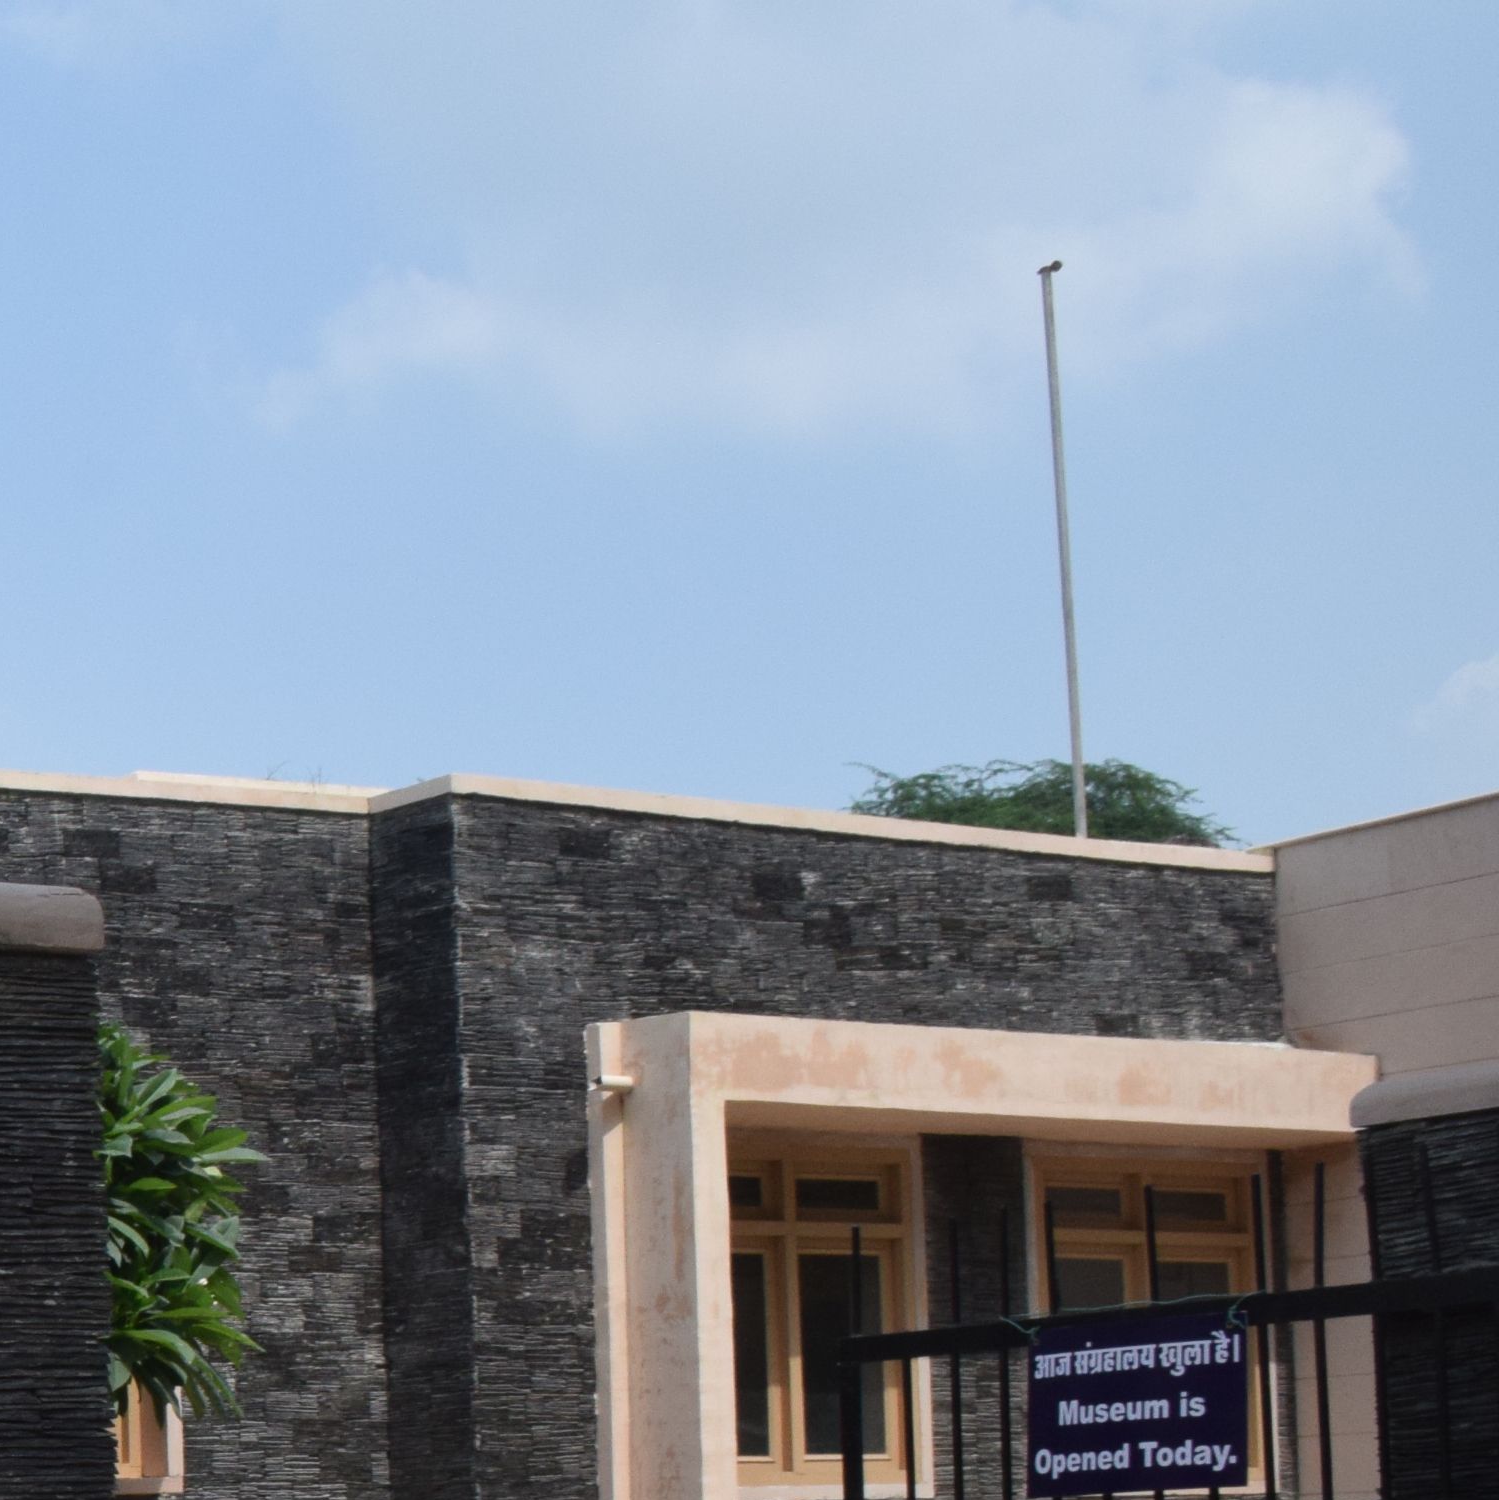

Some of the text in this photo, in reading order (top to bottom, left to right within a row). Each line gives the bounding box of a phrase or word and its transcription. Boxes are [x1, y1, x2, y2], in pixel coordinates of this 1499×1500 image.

[1034, 1351, 1072, 1380] आज
[1074, 1341, 1157, 1376] संग्रहालय
[1158, 1339, 1212, 1378] खुला
[1058, 1391, 1206, 1427] Museum is
[1034, 1439, 1238, 1480] Opened Today.
